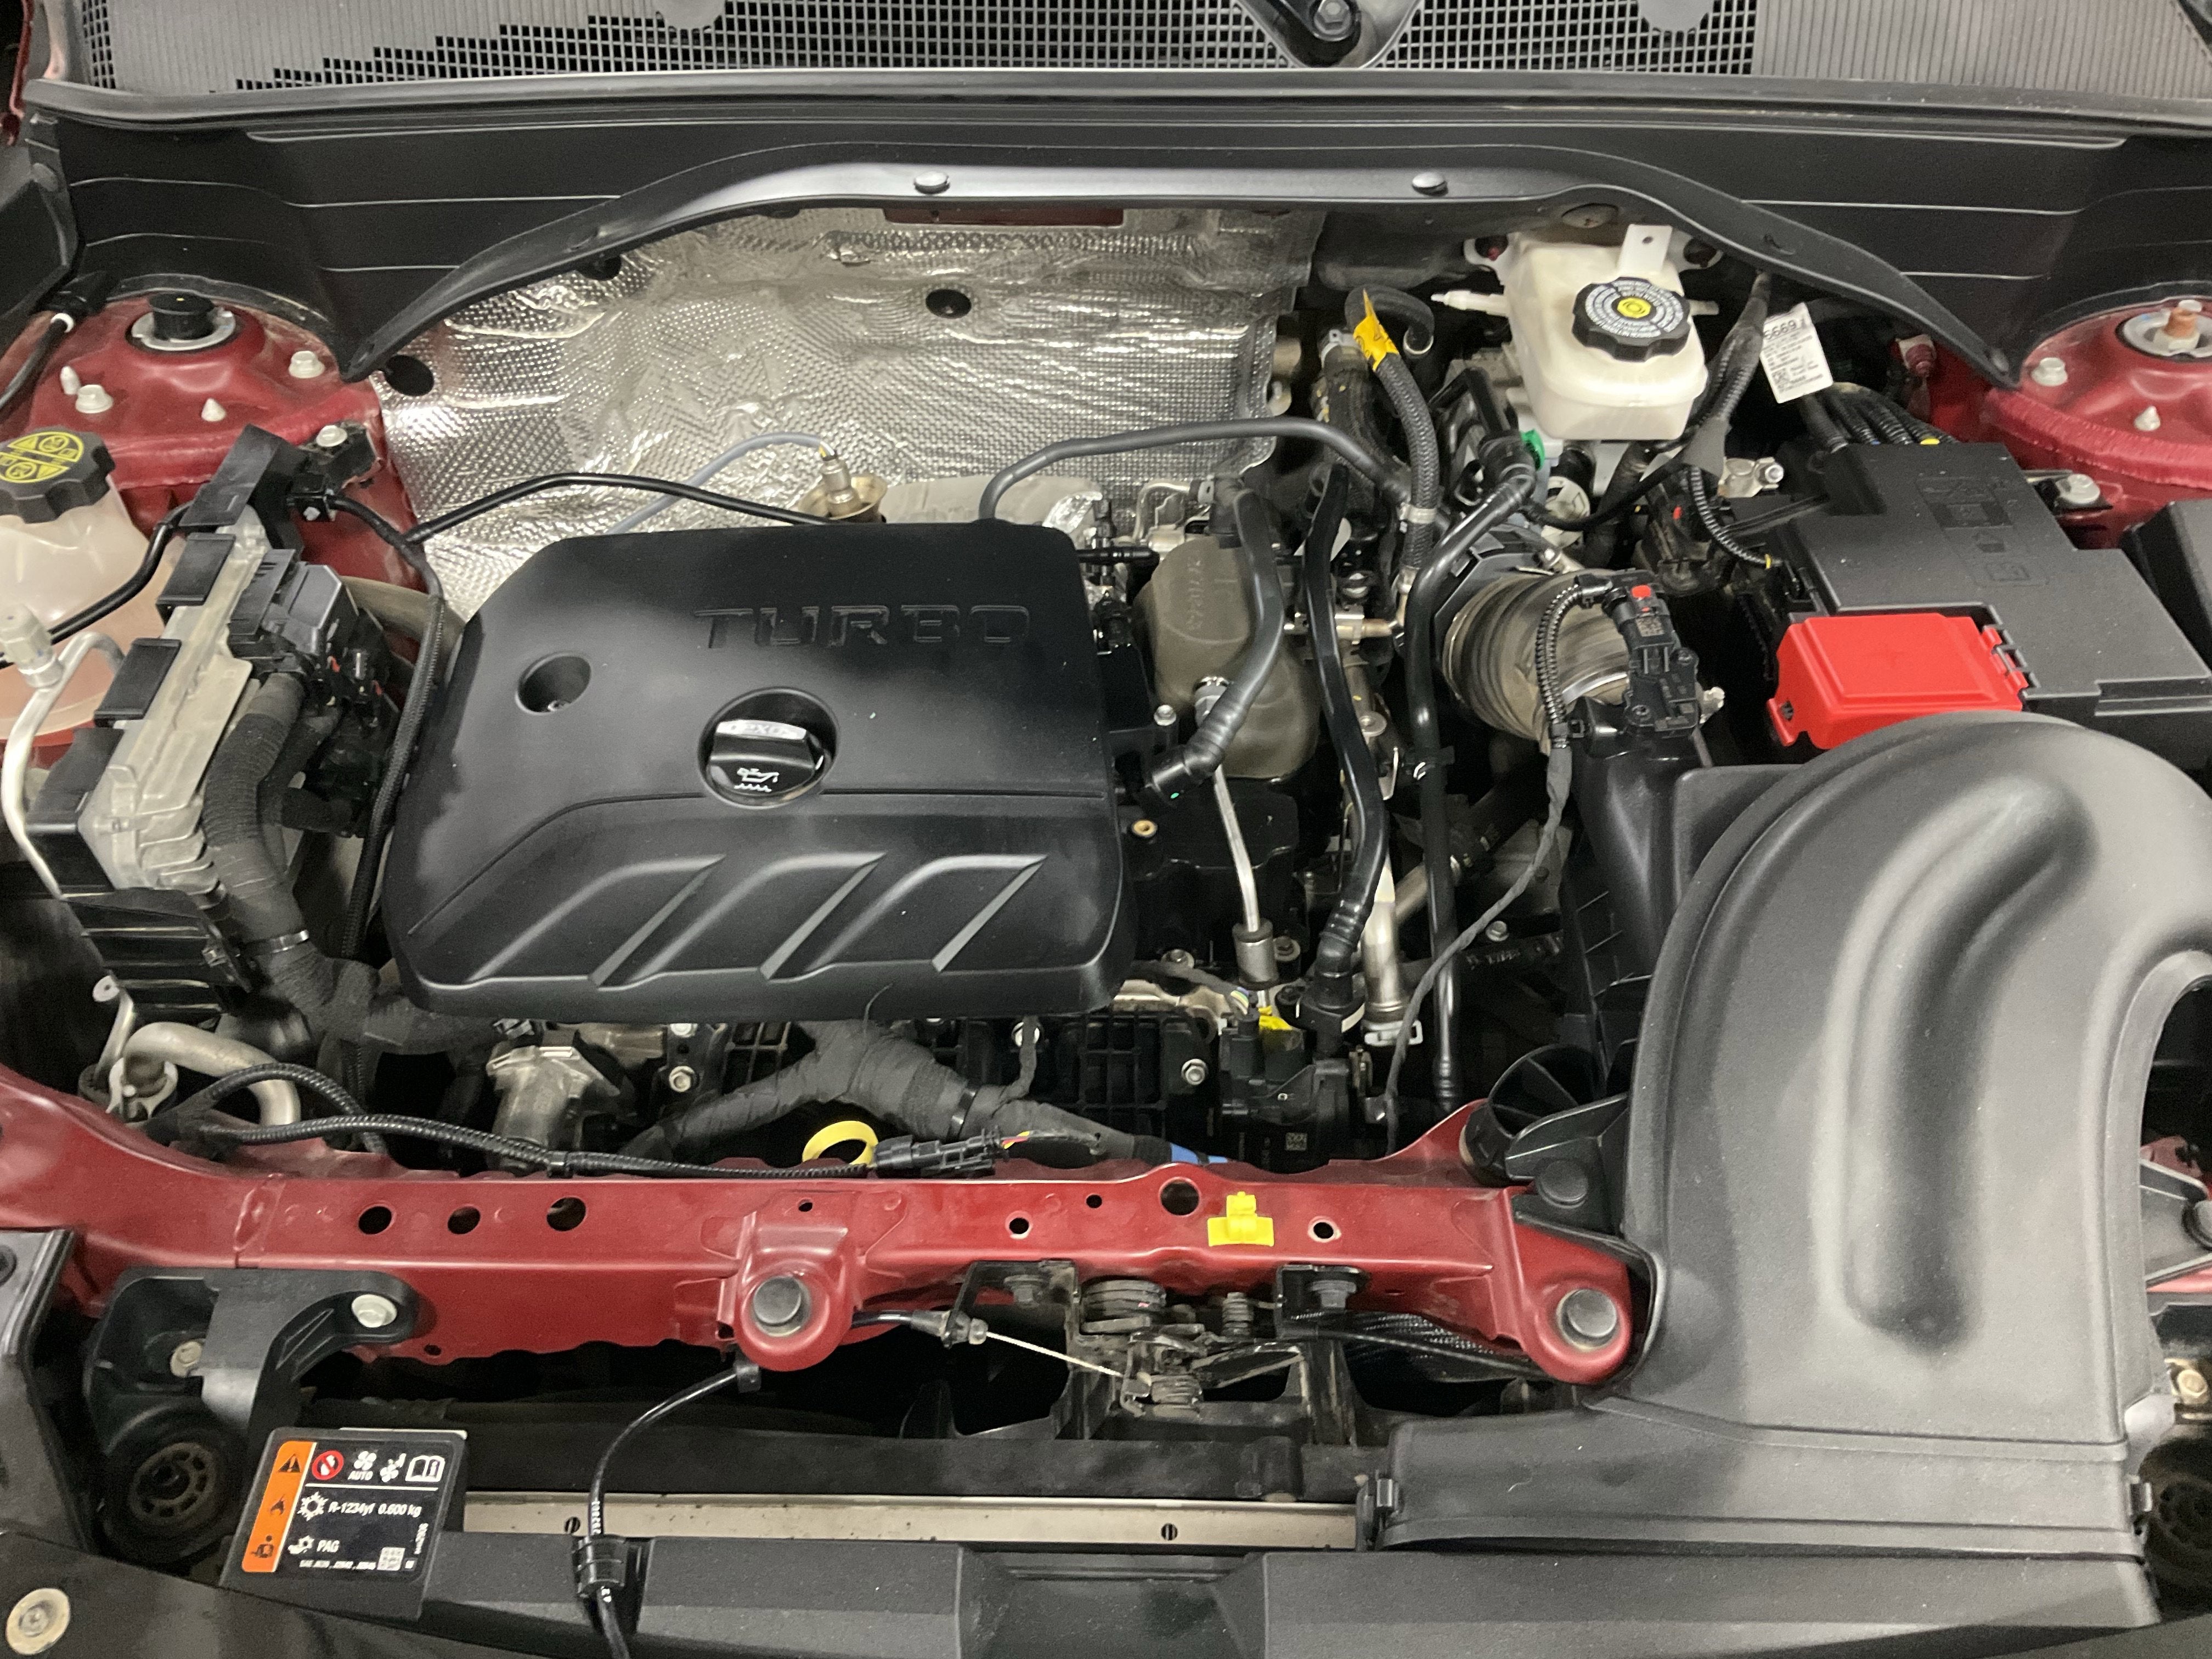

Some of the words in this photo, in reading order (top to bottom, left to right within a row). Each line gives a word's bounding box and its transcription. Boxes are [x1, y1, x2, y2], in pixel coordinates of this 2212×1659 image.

[694, 604, 1030, 649] TURBO
[347, 1470, 374, 1481] AUTO
[317, 1540, 340, 1553] PAG
